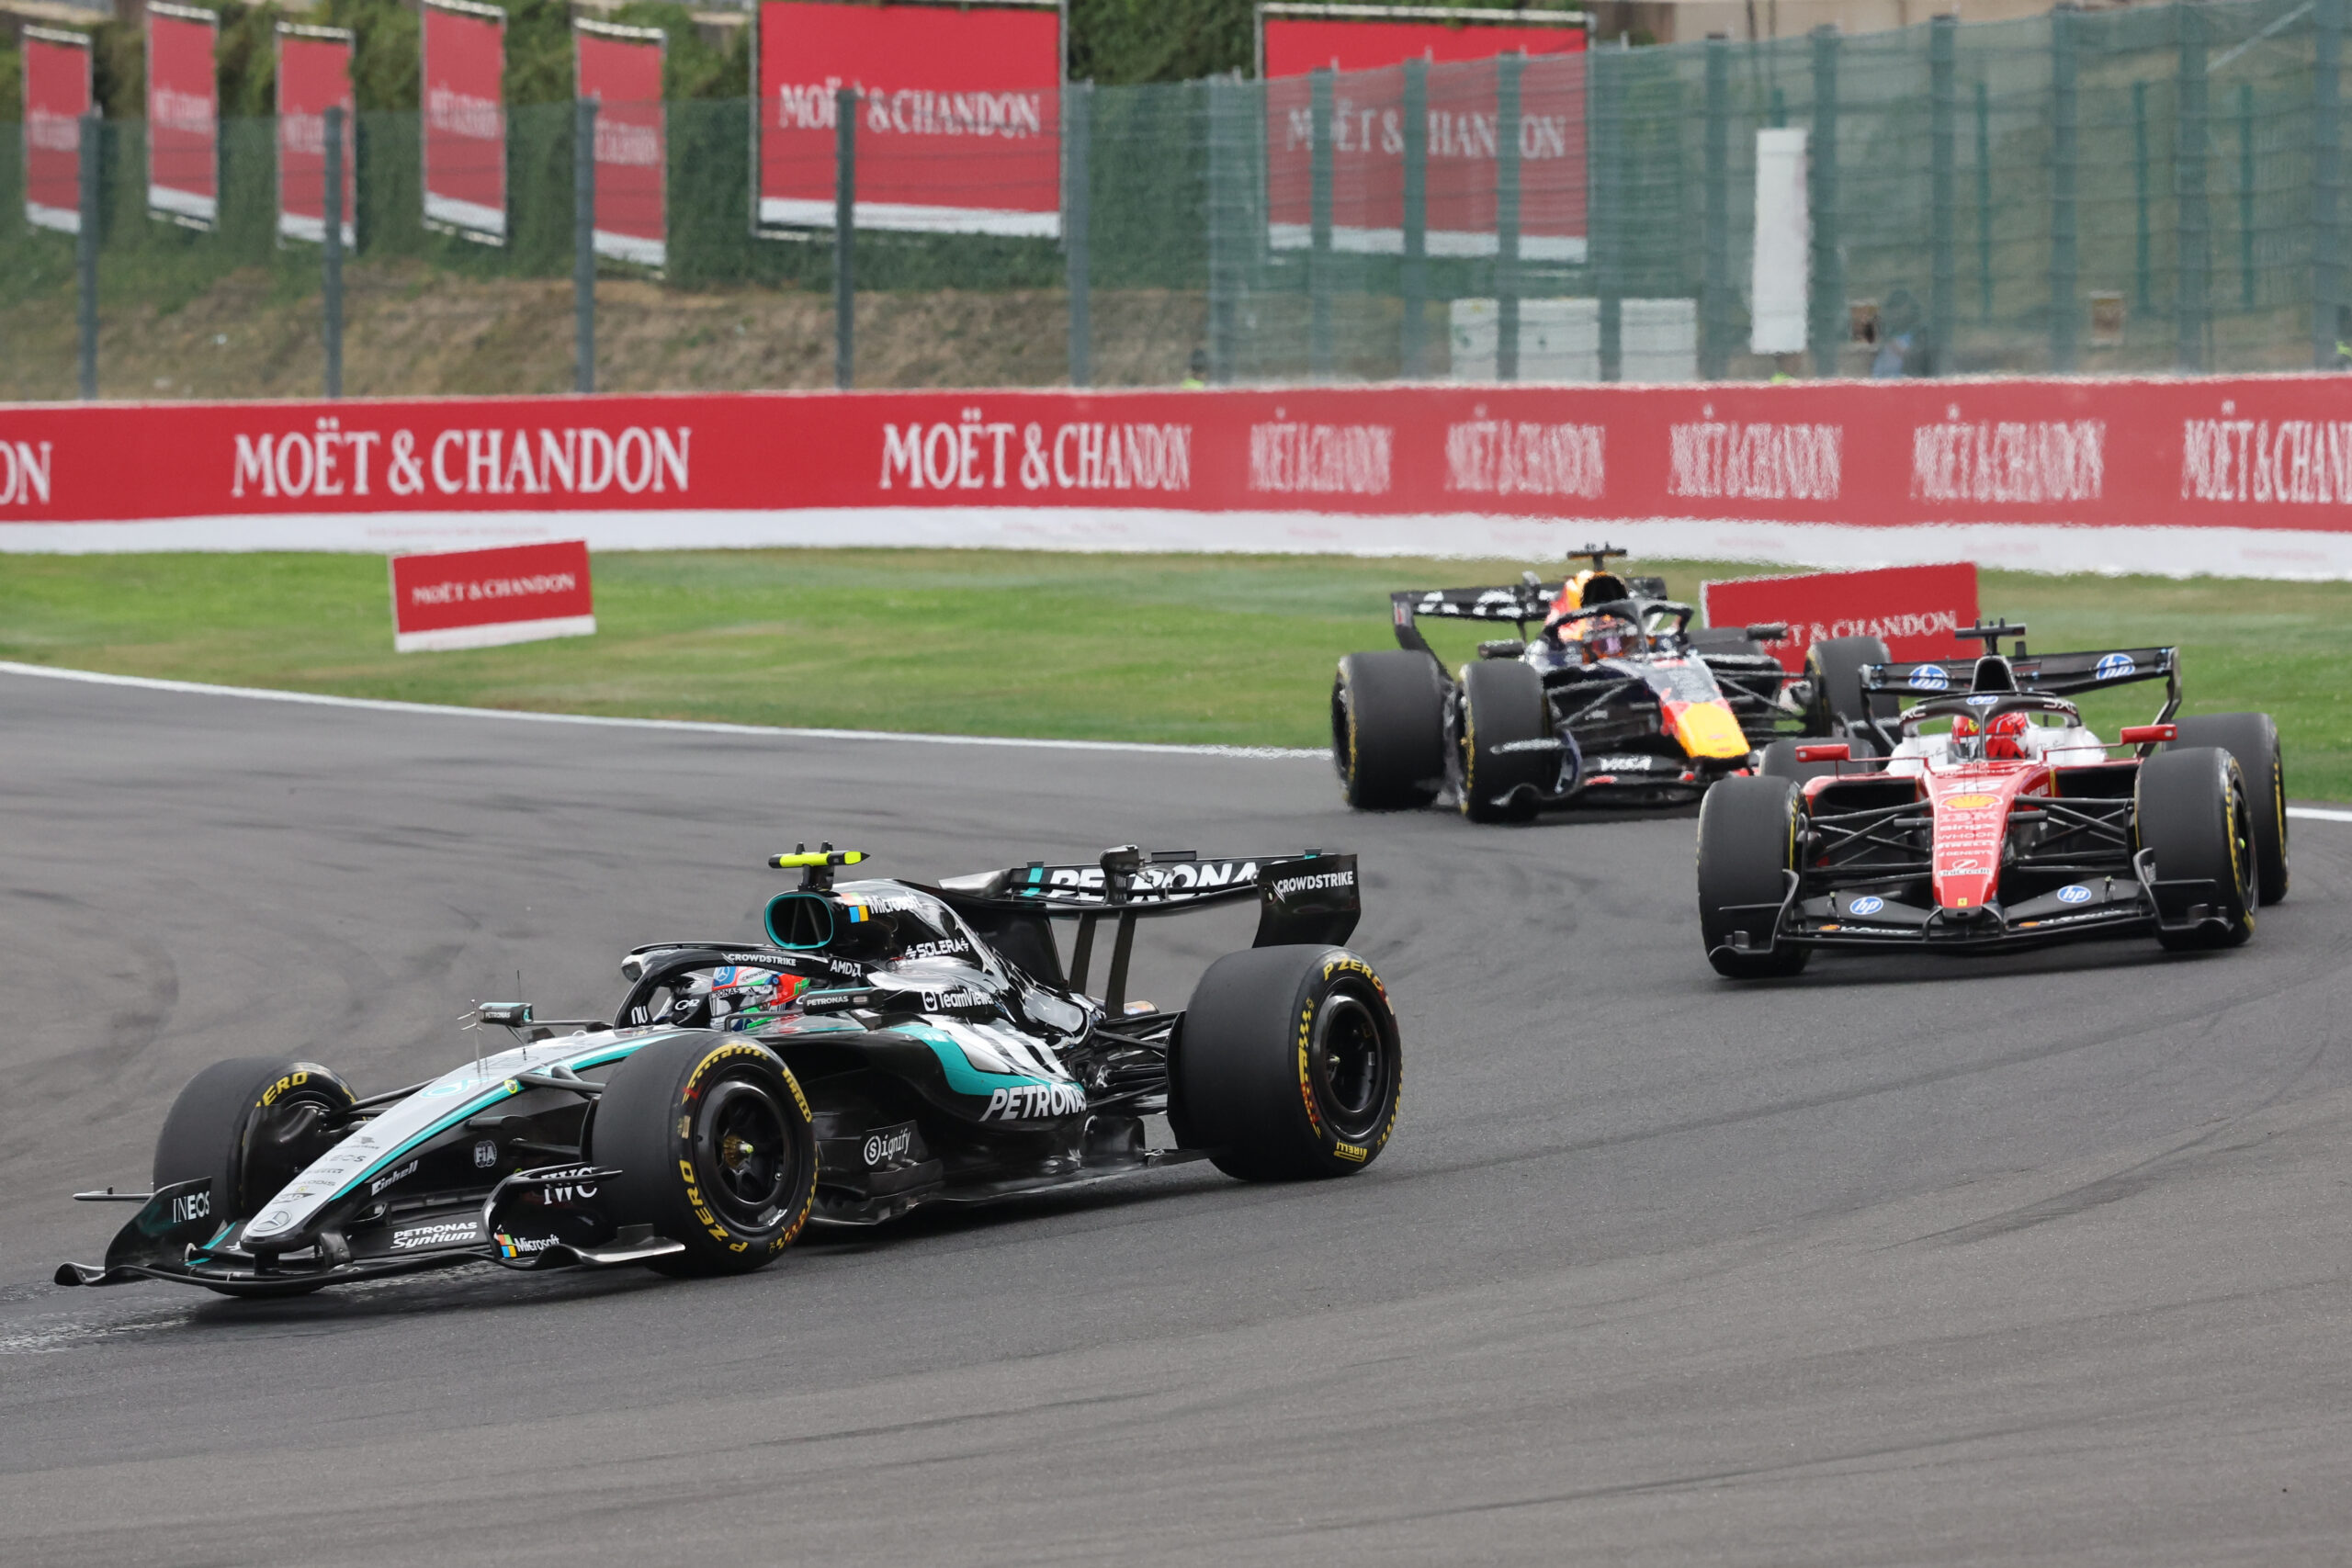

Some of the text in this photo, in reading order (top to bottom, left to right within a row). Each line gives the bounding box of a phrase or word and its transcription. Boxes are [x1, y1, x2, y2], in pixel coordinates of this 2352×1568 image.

[779, 76, 1040, 138] MOË & CHANDON
[1287, 97, 1566, 160] MËT & HANON
[232, 416, 691, 497] MOËT & CHANDON
[879, 406, 1016, 491] MOËT
[1020, 421, 1050, 491] &
[1053, 422, 1193, 491] CHANDON
[2273, 420, 2352, 504] CHAN
[482, 572, 576, 599] CHANDON
[1831, 609, 1957, 640] CHANDON
[1046, 860, 1289, 904] PERONA
[1276, 871, 1354, 895] CROWDSTRIKE
[1855, 896, 1881, 914] hp
[2063, 886, 2090, 903] hp
[727, 953, 797, 966] CROWDSTRIKE
[916, 939, 963, 959] SOLERA
[830, 959, 854, 976] AMD
[806, 995, 849, 1007] PETRONAS
[937, 987, 995, 1009] TeamViewer
[475, 1145, 495, 1163] FIA
[371, 1159, 419, 1197] Einhell
[540, 1167, 598, 1205] IWC
[173, 1190, 210, 1224] INEOS
[390, 1231, 477, 1249] Syntium
[393, 1222, 478, 1239] PETRONAS
[514, 1234, 560, 1253] Microsoft
